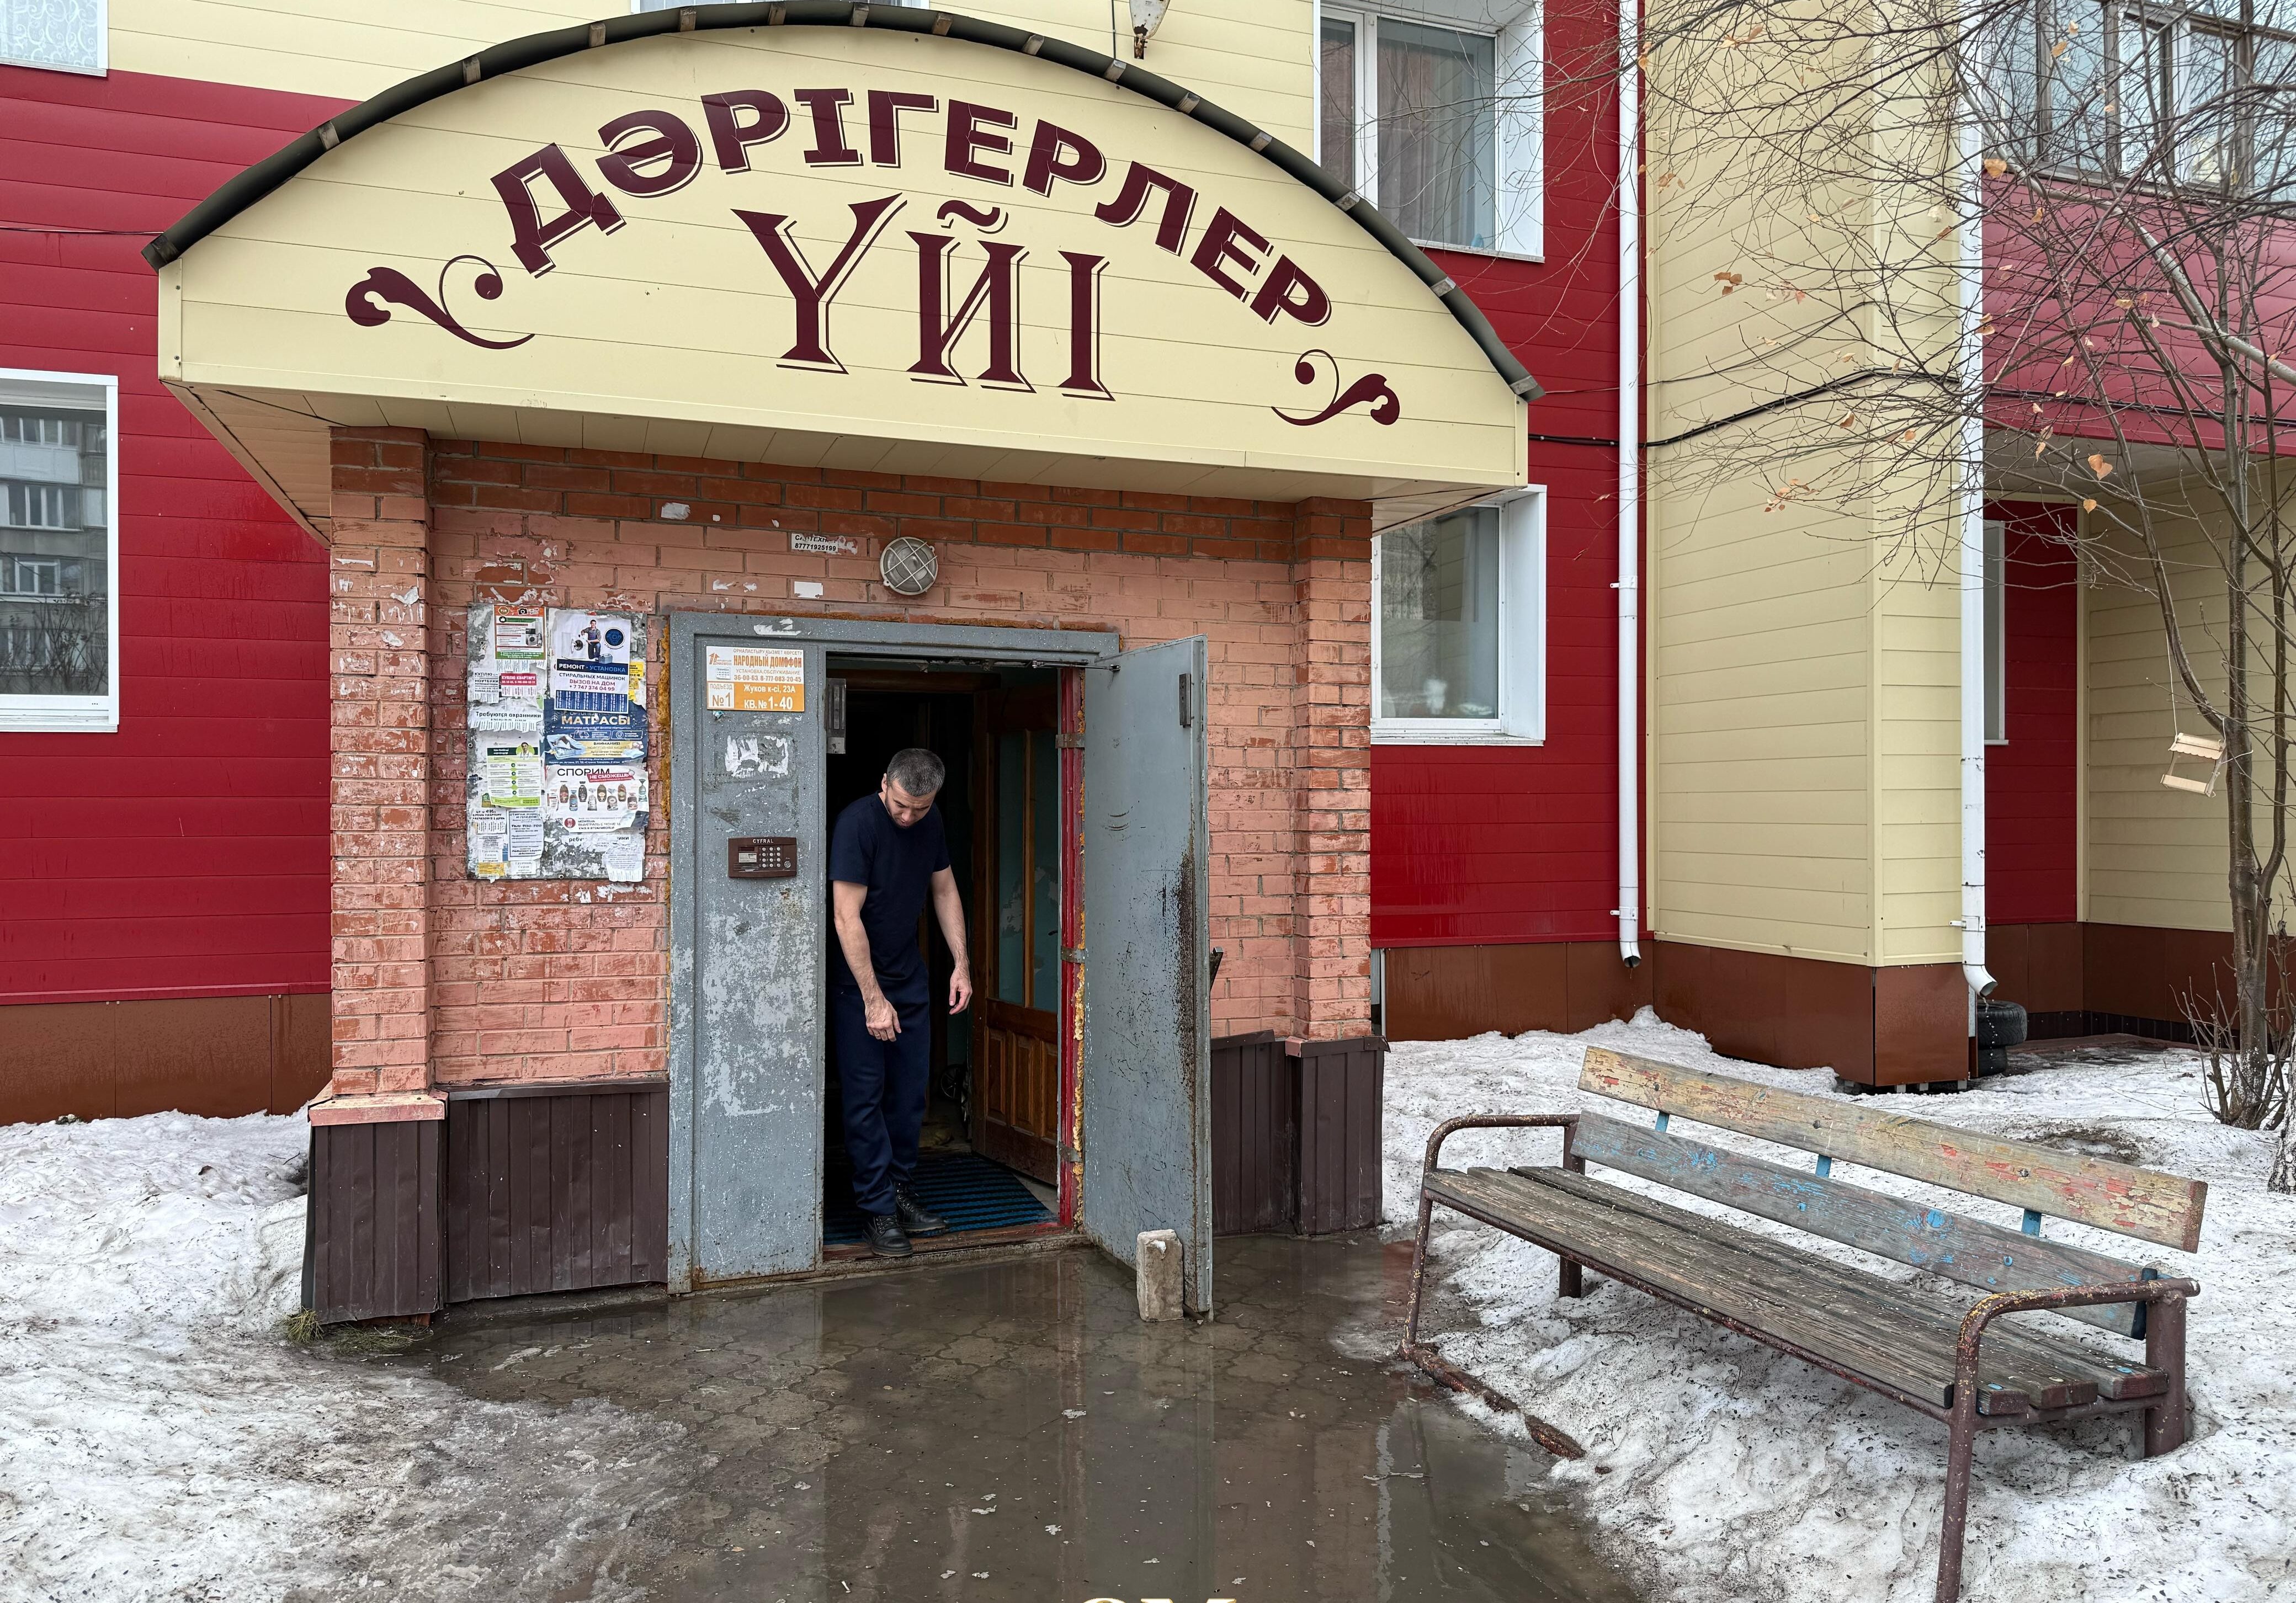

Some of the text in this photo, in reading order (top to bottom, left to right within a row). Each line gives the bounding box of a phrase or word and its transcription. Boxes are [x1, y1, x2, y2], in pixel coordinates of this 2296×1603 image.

[490, 87, 1332, 328] ДӘРІГЕРЛЕР
[730, 193, 1116, 402] ҮЙІ
[795, 543, 836, 551] 87771925199
[734, 654, 802, 668] НАРОДНЫЙ ДОМОФОН
[743, 684, 766, 694] Жуков
[557, 768, 610, 776] СПОРИМ
